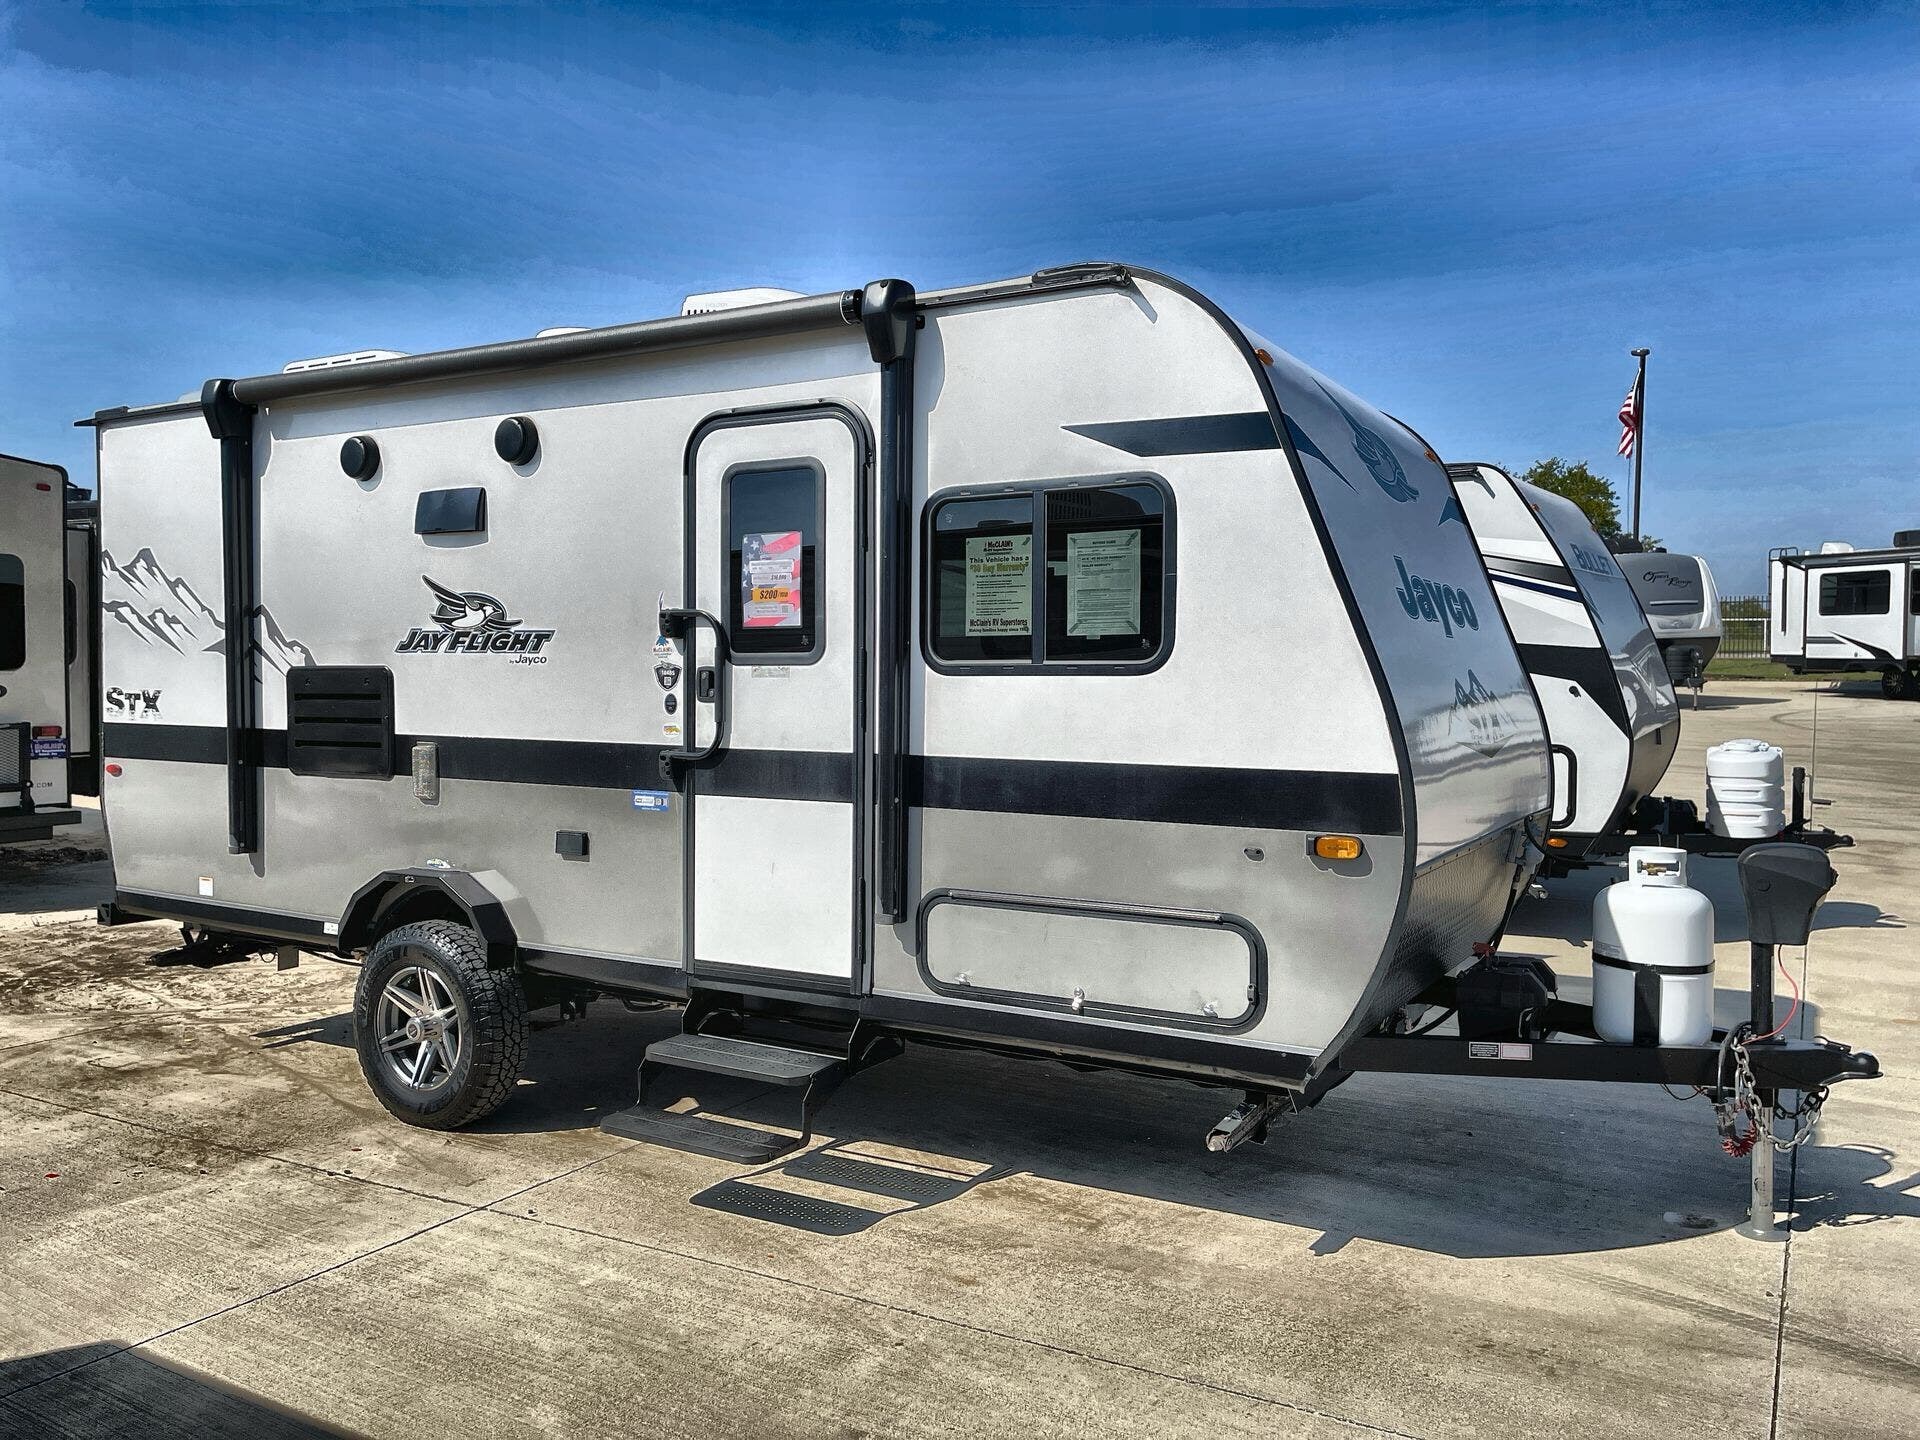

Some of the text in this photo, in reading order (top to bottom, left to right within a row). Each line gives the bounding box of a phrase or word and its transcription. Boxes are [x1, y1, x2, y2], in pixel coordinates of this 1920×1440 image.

[1570, 543, 1614, 576] BULLET
[1643, 570, 1693, 588] Open Range
[760, 590, 778, 599] $200
[1393, 554, 1480, 639] Jayco
[395, 628, 556, 654] JAY FLIGHT
[515, 655, 547, 666] Jayco
